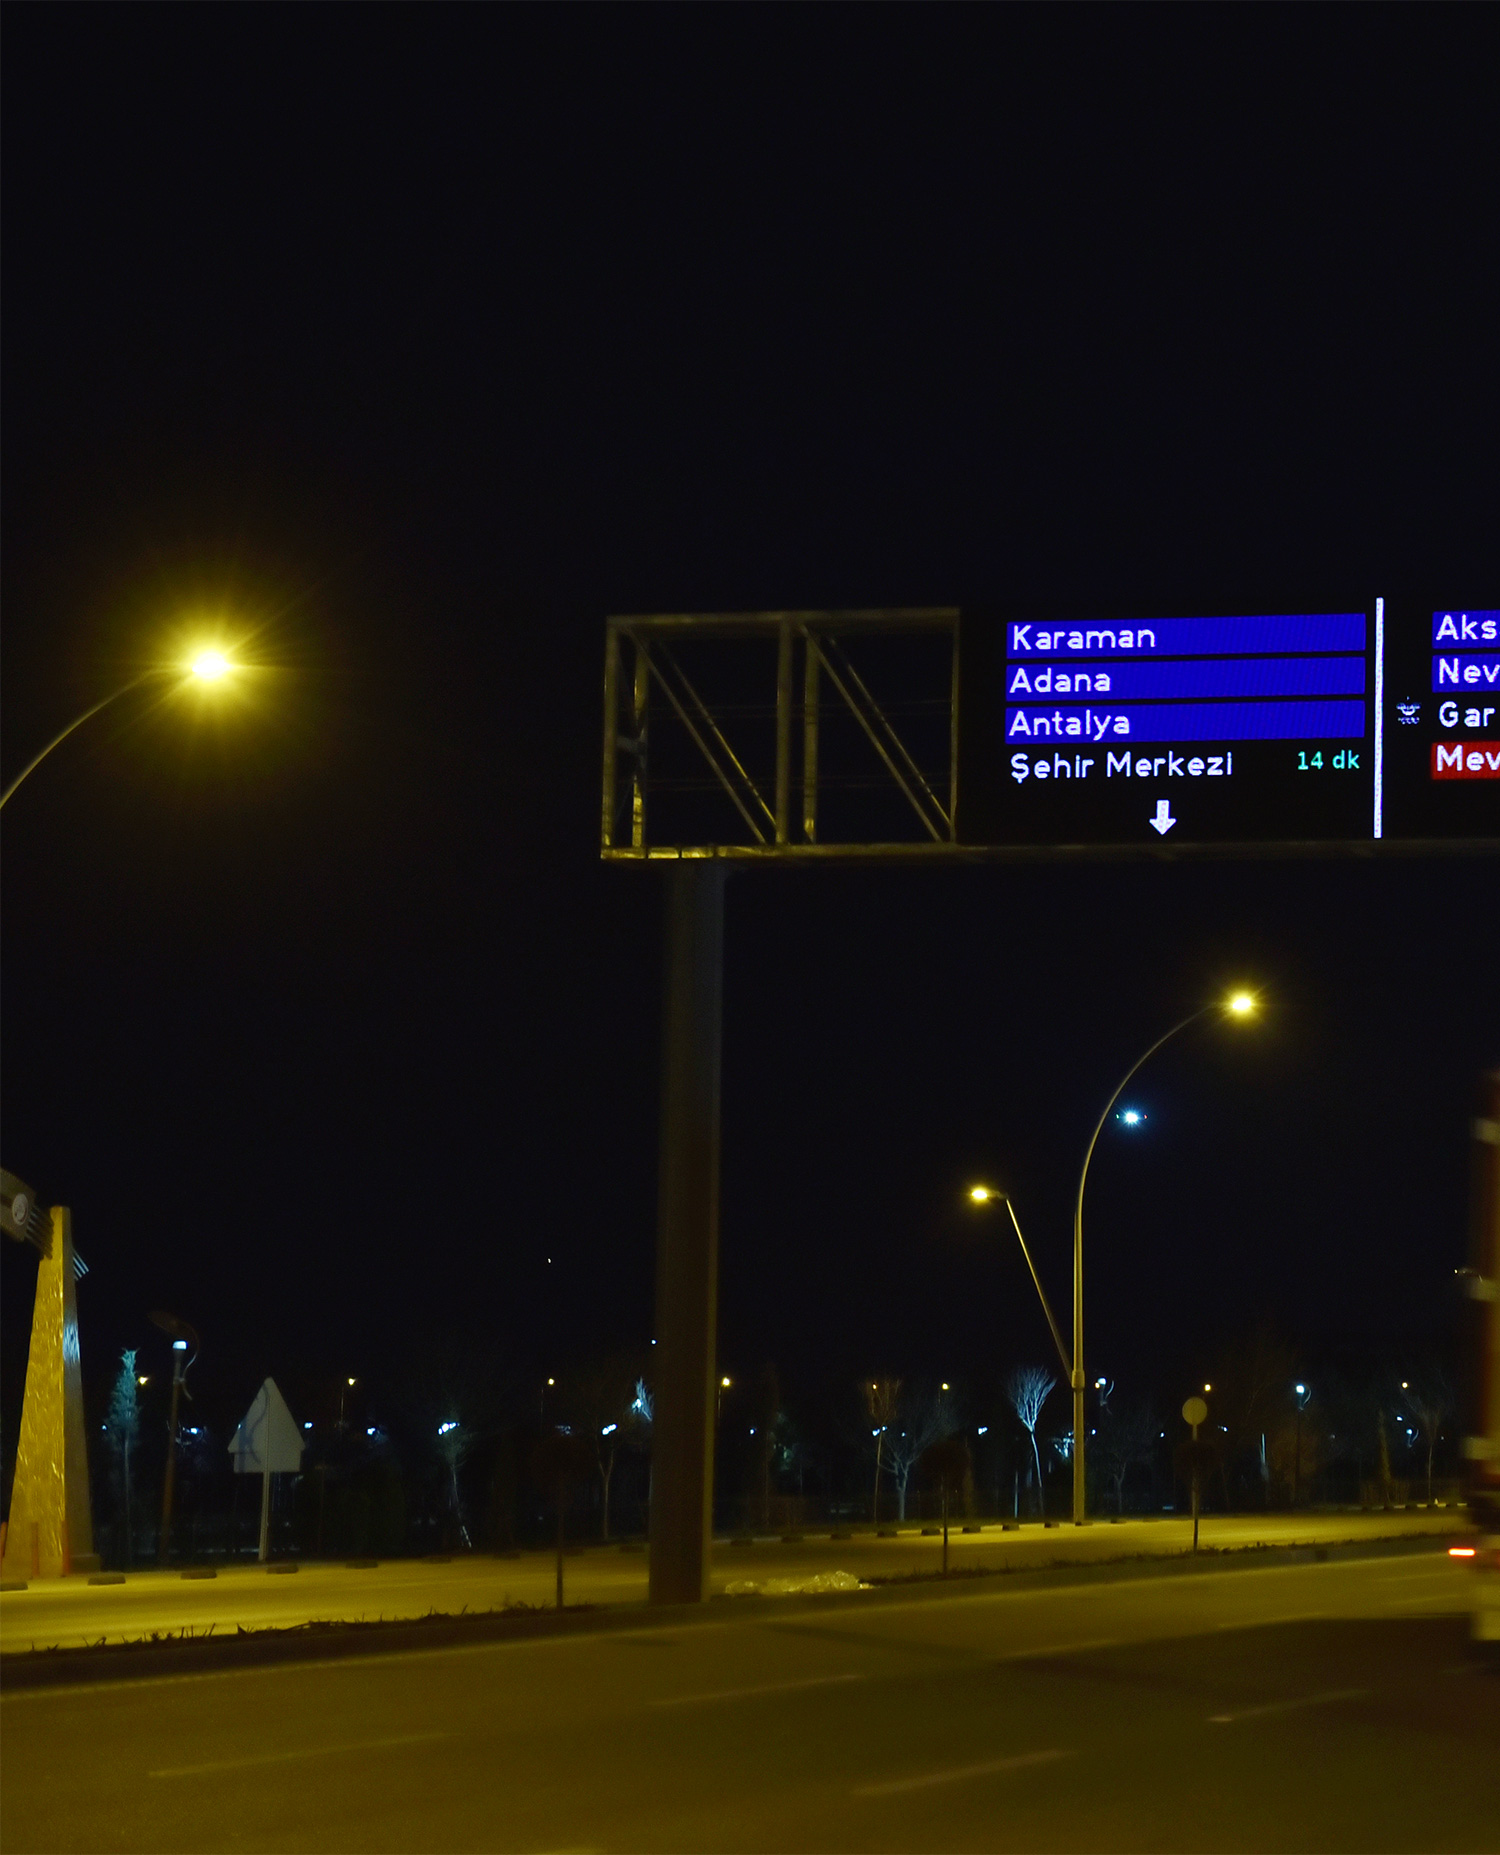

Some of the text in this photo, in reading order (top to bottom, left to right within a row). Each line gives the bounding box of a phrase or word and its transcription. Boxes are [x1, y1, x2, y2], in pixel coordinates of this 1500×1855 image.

[1013, 624, 1155, 651] Karaman
[1009, 667, 1111, 694] Adana
[1008, 709, 1130, 741] Antalya
[1438, 701, 1495, 728] Gar
[1010, 749, 1360, 784] Şehir Merkezi 14 dk
